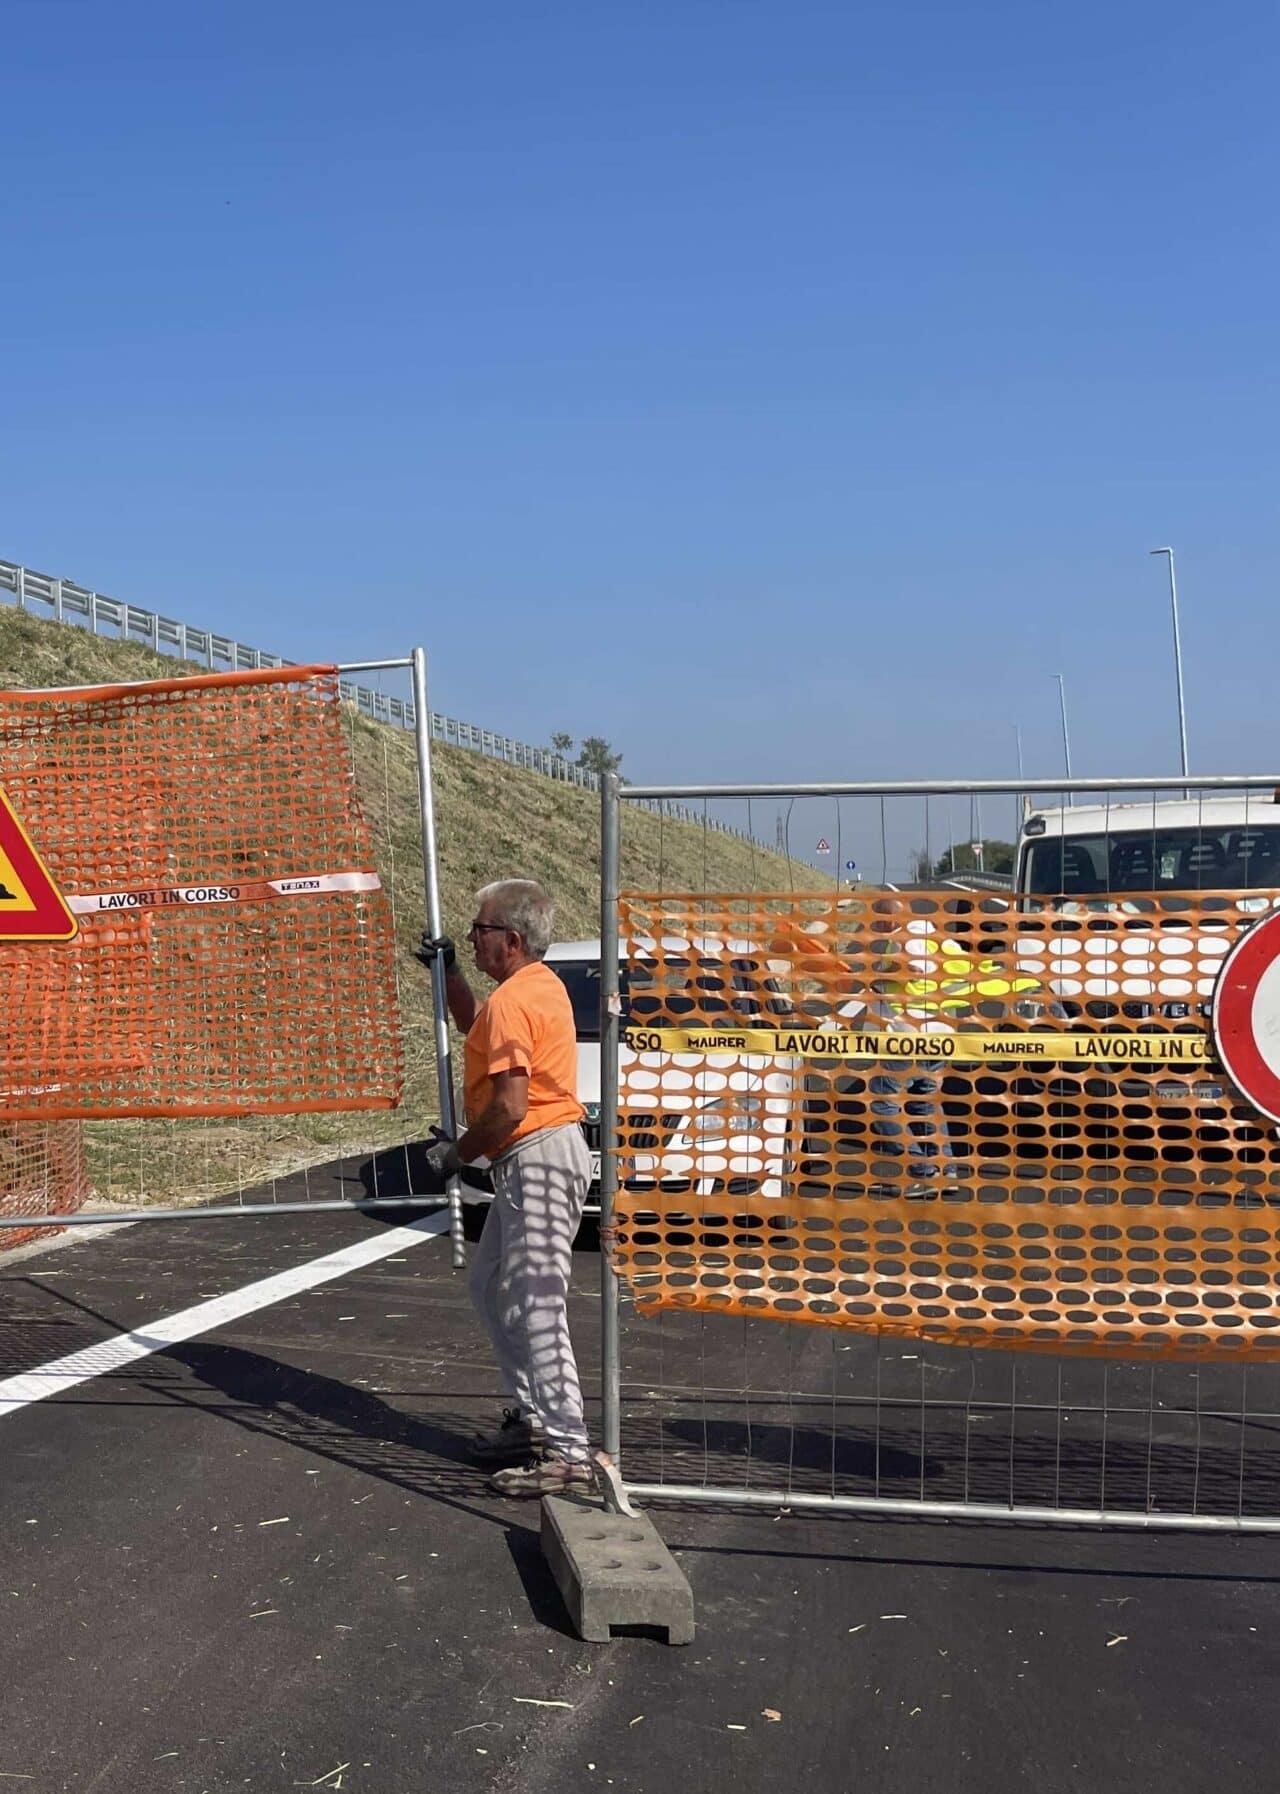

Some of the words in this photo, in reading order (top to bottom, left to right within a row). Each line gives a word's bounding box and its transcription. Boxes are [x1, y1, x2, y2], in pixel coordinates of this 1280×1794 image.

[99, 892, 156, 909] LAVORI
[161, 890, 180, 904] IN
[185, 887, 240, 902] CORSO
[281, 880, 320, 891] TENAX
[687, 1037, 746, 1048] MAURER
[774, 1034, 849, 1054] LAVORI
[855, 1035, 879, 1055] IN
[885, 1037, 955, 1056] CORSO
[983, 1042, 1045, 1054] MAURER
[1075, 1038, 1153, 1057] LAVORI
[1159, 1038, 1183, 1057] IN
